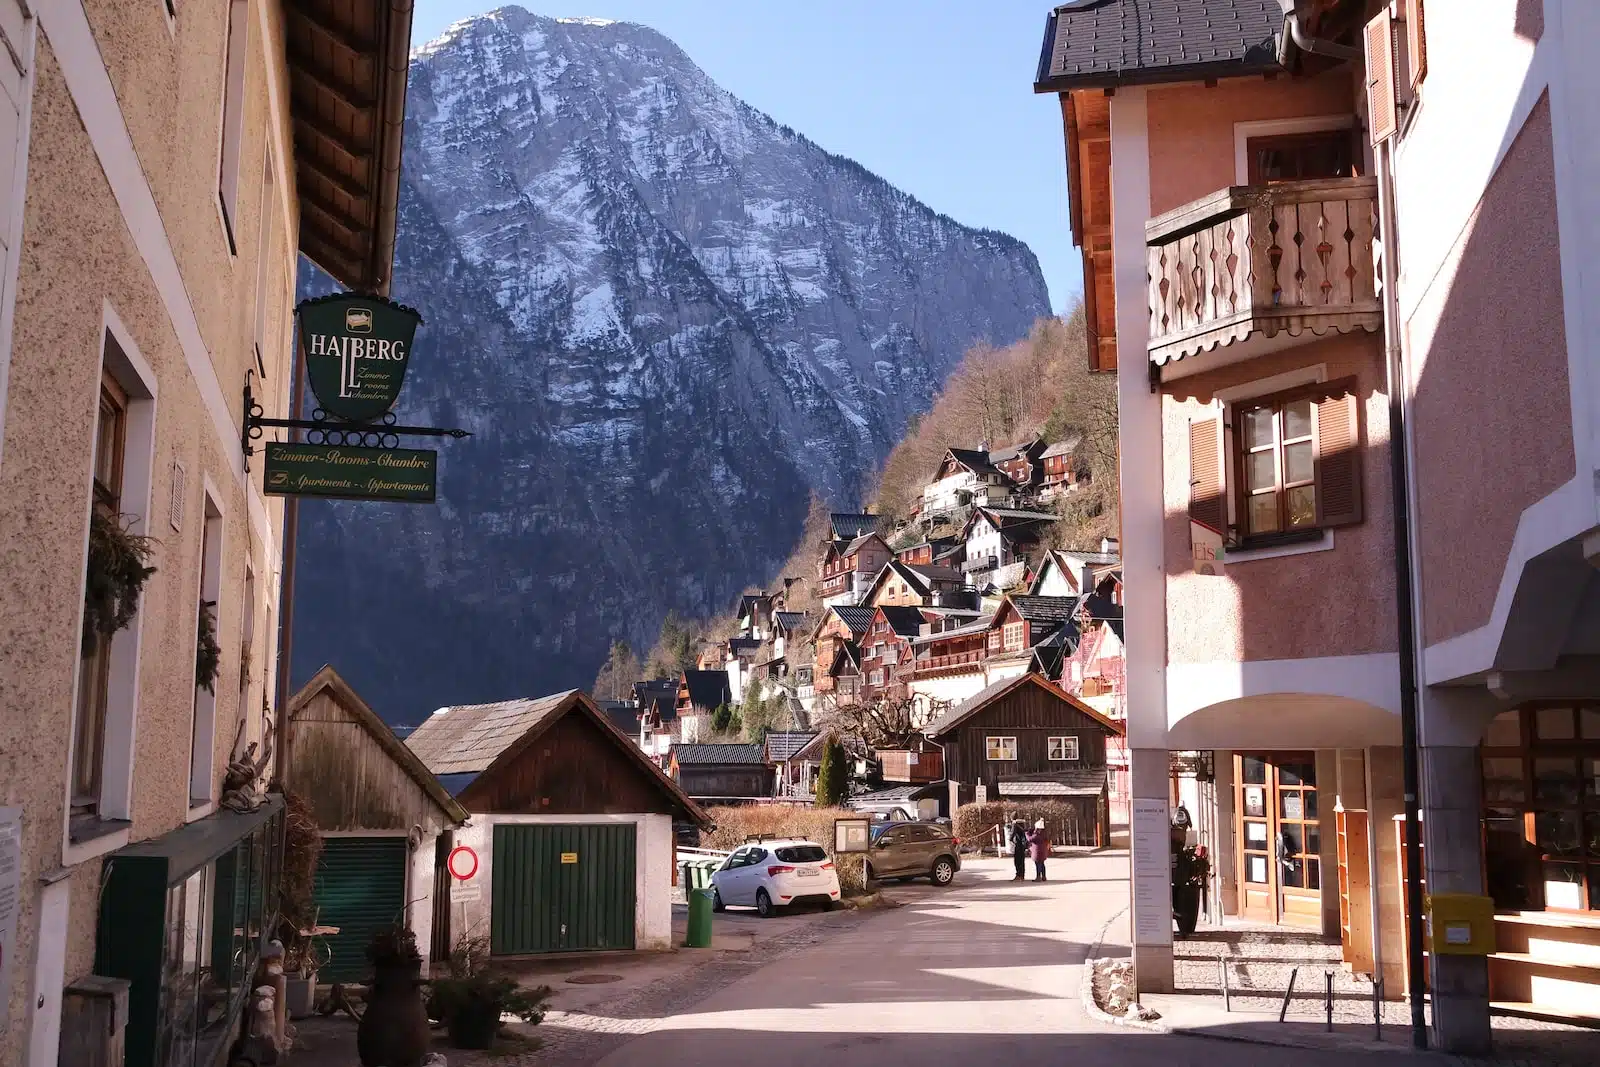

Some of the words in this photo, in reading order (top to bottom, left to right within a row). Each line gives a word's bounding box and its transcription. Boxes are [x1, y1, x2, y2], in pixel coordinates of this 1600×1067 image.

[357, 366, 391, 380] Zimmer
[291, 473, 352, 490] Apartments
[361, 477, 430, 493] Appartements
